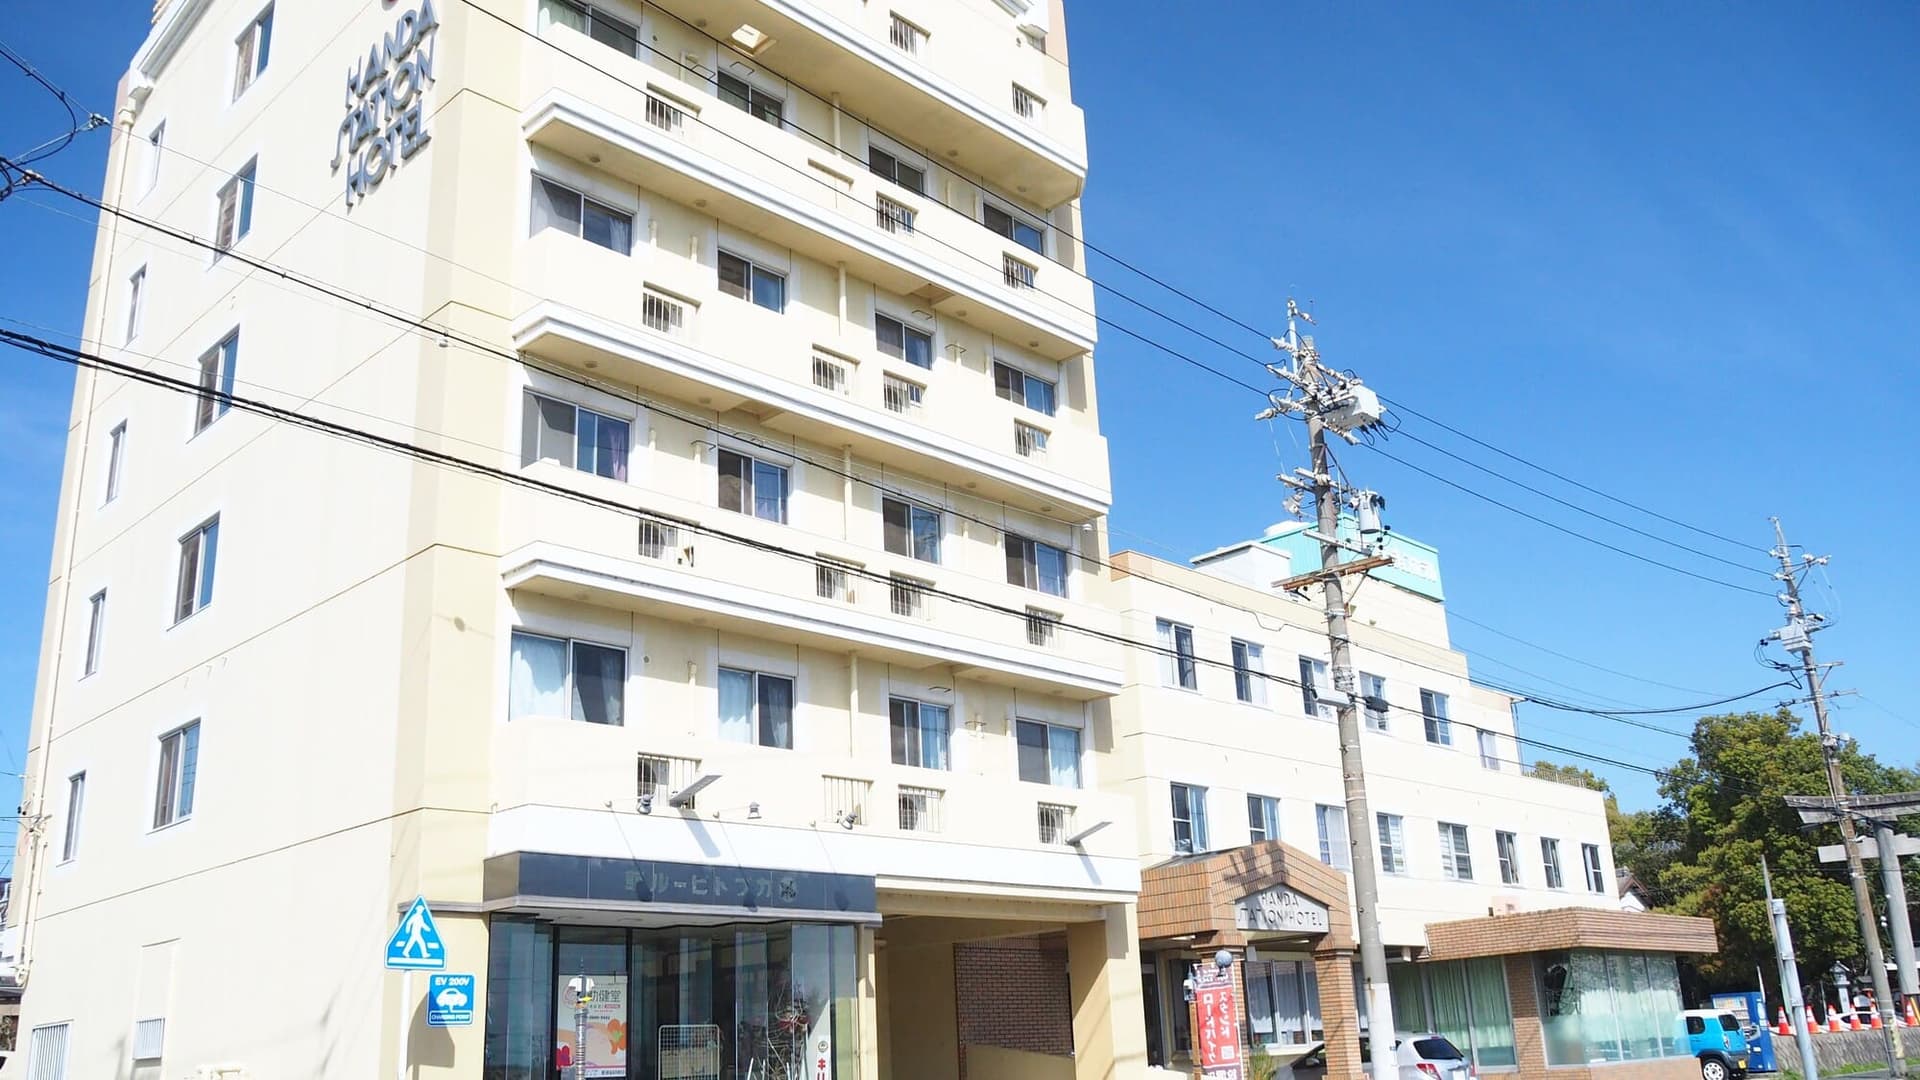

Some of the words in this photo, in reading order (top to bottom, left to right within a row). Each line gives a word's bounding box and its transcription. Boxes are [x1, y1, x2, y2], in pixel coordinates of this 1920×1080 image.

[345, 0, 439, 110] HANDA
[330, 33, 436, 169] STATION
[346, 99, 432, 208] HOTEL
[1237, 907, 1285, 924] STATION
[1288, 910, 1323, 926] HOTEL
[1262, 891, 1299, 907] HANDA
[435, 977, 447, 986] EV
[448, 977, 470, 986] 200V
